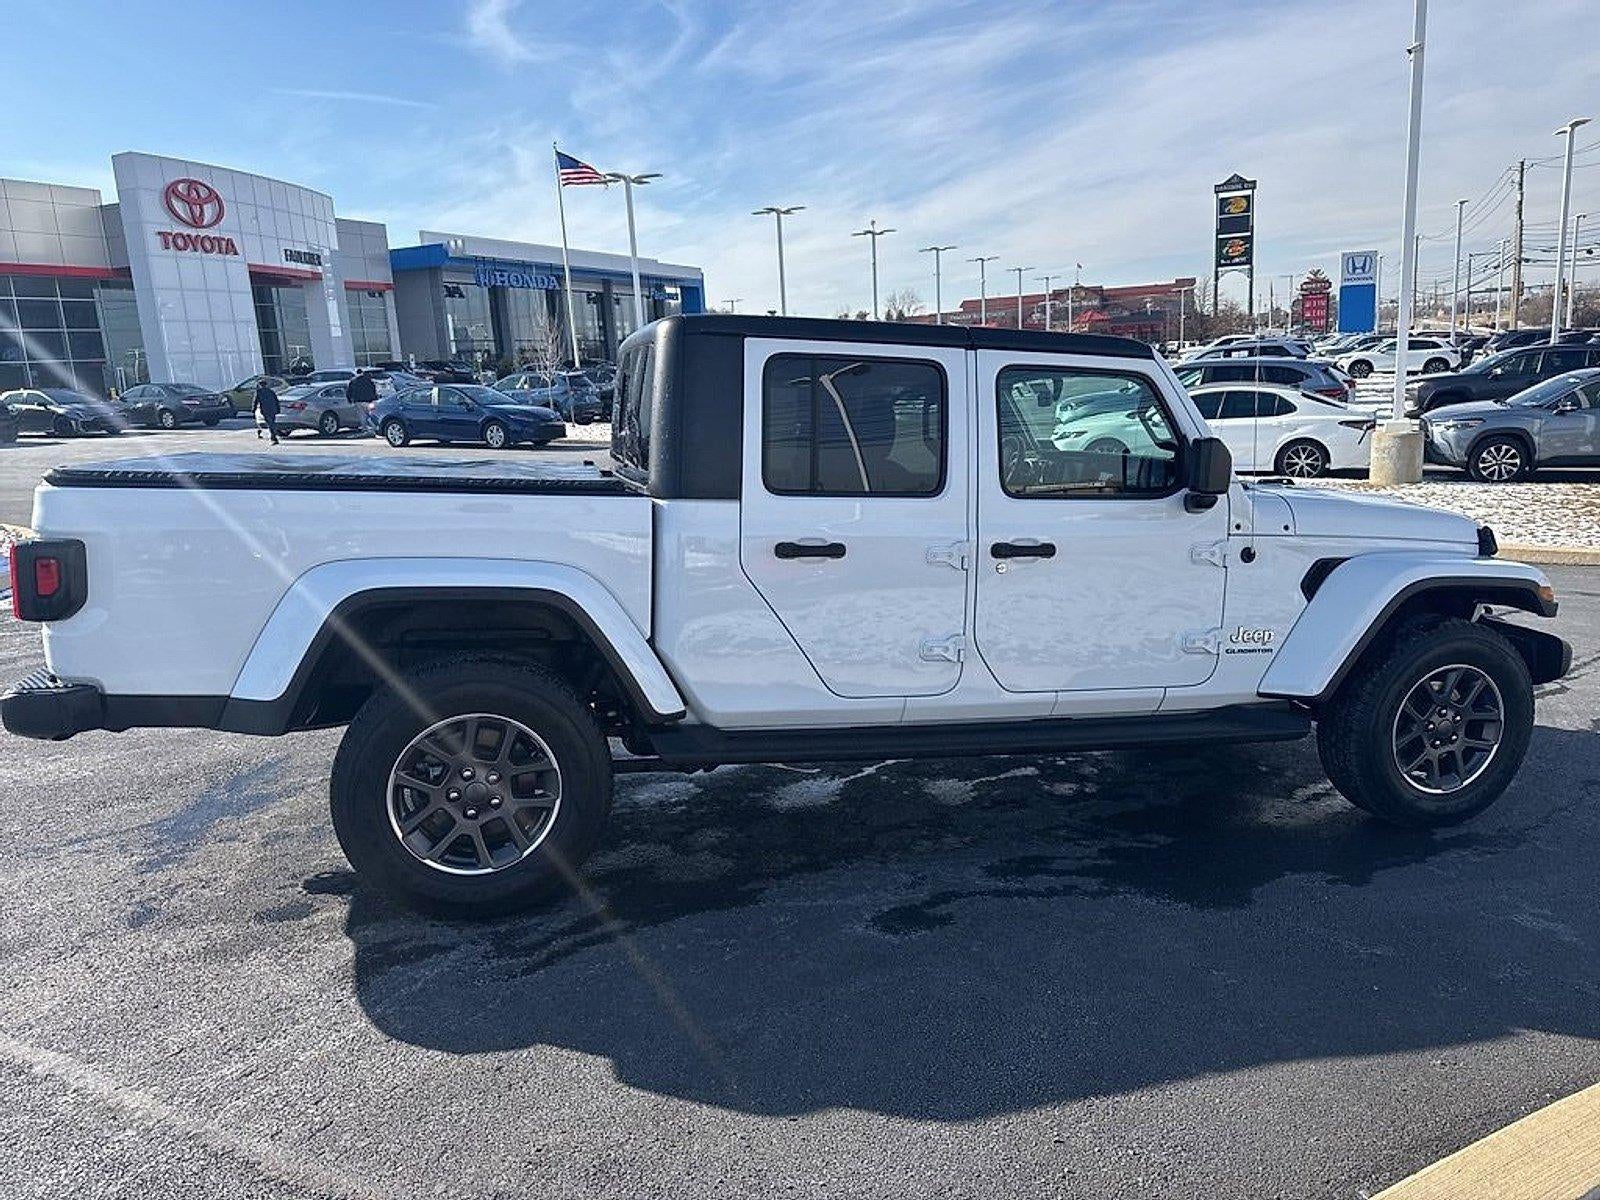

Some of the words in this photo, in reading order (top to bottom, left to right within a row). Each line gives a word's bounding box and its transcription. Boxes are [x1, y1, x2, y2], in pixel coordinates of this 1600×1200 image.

[157, 231, 239, 255] TOYOTA
[493, 271, 560, 290] HONDA
[1230, 626, 1275, 646] Jeep
